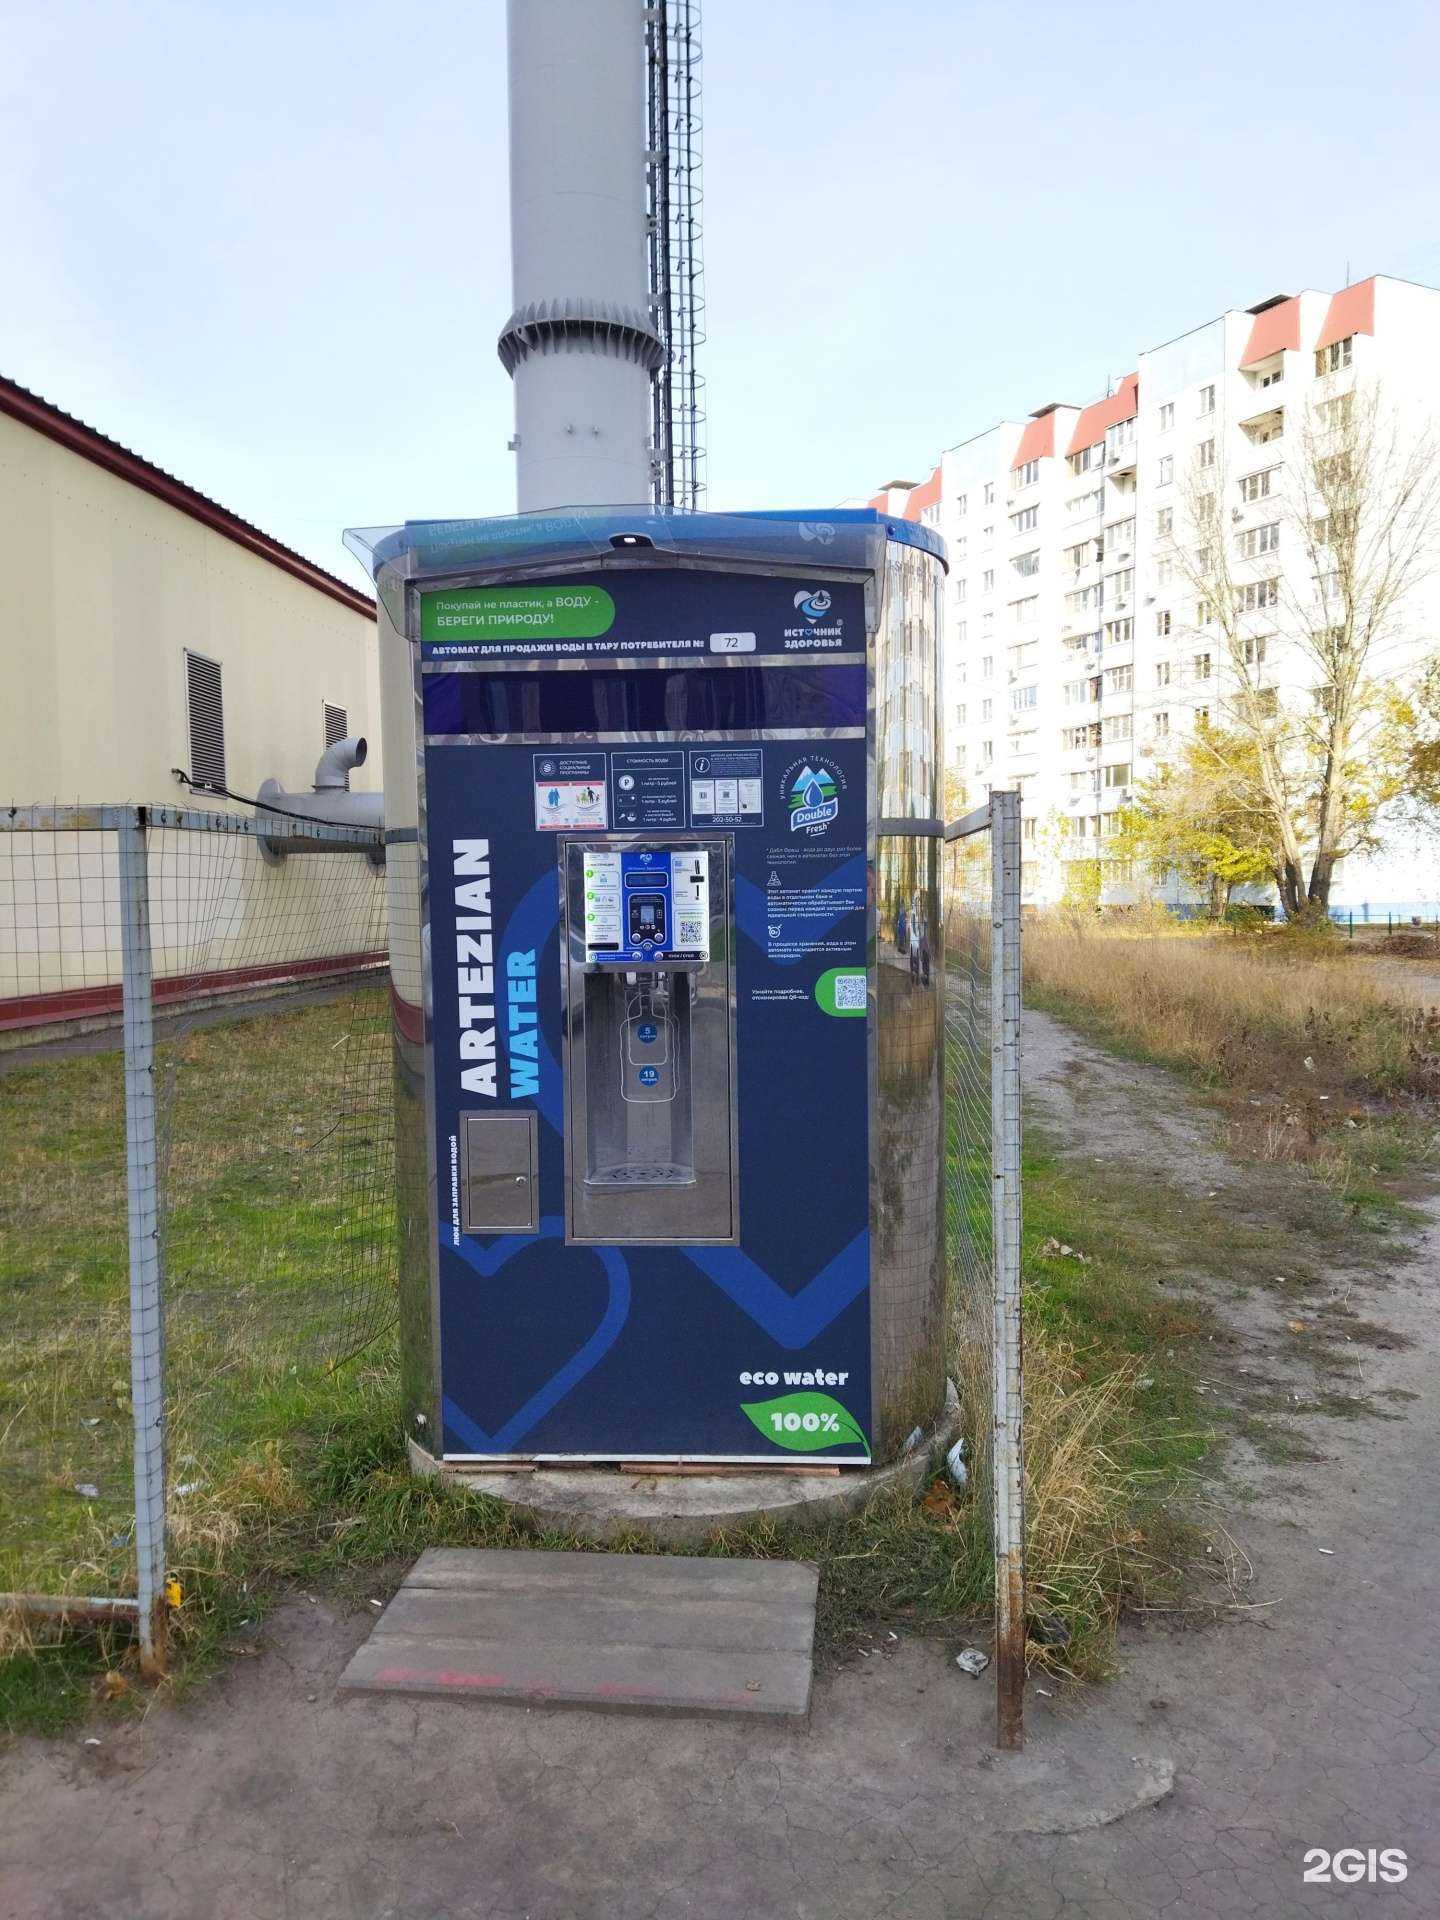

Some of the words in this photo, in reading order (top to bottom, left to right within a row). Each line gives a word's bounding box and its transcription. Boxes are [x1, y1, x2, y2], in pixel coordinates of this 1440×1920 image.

[436, 601, 481, 612] Покупай
[499, 601, 544, 610] пластик,
[555, 596, 591, 608] ВОДУ
[437, 615, 485, 626] БЕРЕГИ
[488, 613, 554, 626] ПРИРОДУ!
[432, 645, 480, 655] АВТОМАТ
[480, 645, 501, 655] ДЛЯ
[503, 643, 554, 654] ПРОДАЖИ
[555, 643, 585, 652] ВОДЫ
[586, 642, 593, 651] В
[595, 642, 619, 651] ТАРУ
[620, 640, 692, 650] ПОТРЕБИТЕЛЯ
[693, 640, 705, 648] №
[724, 637, 738, 648] 72
[784, 638, 843, 649] ЗДОРОВЬЯ
[810, 755, 848, 790] ТЕХНОЛОГИЯ
[797, 806, 832, 823] Double
[452, 839, 498, 1098] ARTEZIAN
[507, 948, 540, 1100] WATER
[643, 1070, 655, 1078] 19
[449, 1135, 458, 1164] ВОДОЙ
[451, 1165, 459, 1207] ЗАПРАВКИ
[452, 1208, 460, 1226] ДЛЯ
[739, 1371, 779, 1385] eco
[783, 1368, 849, 1386] water
[770, 1412, 841, 1432] 100%
